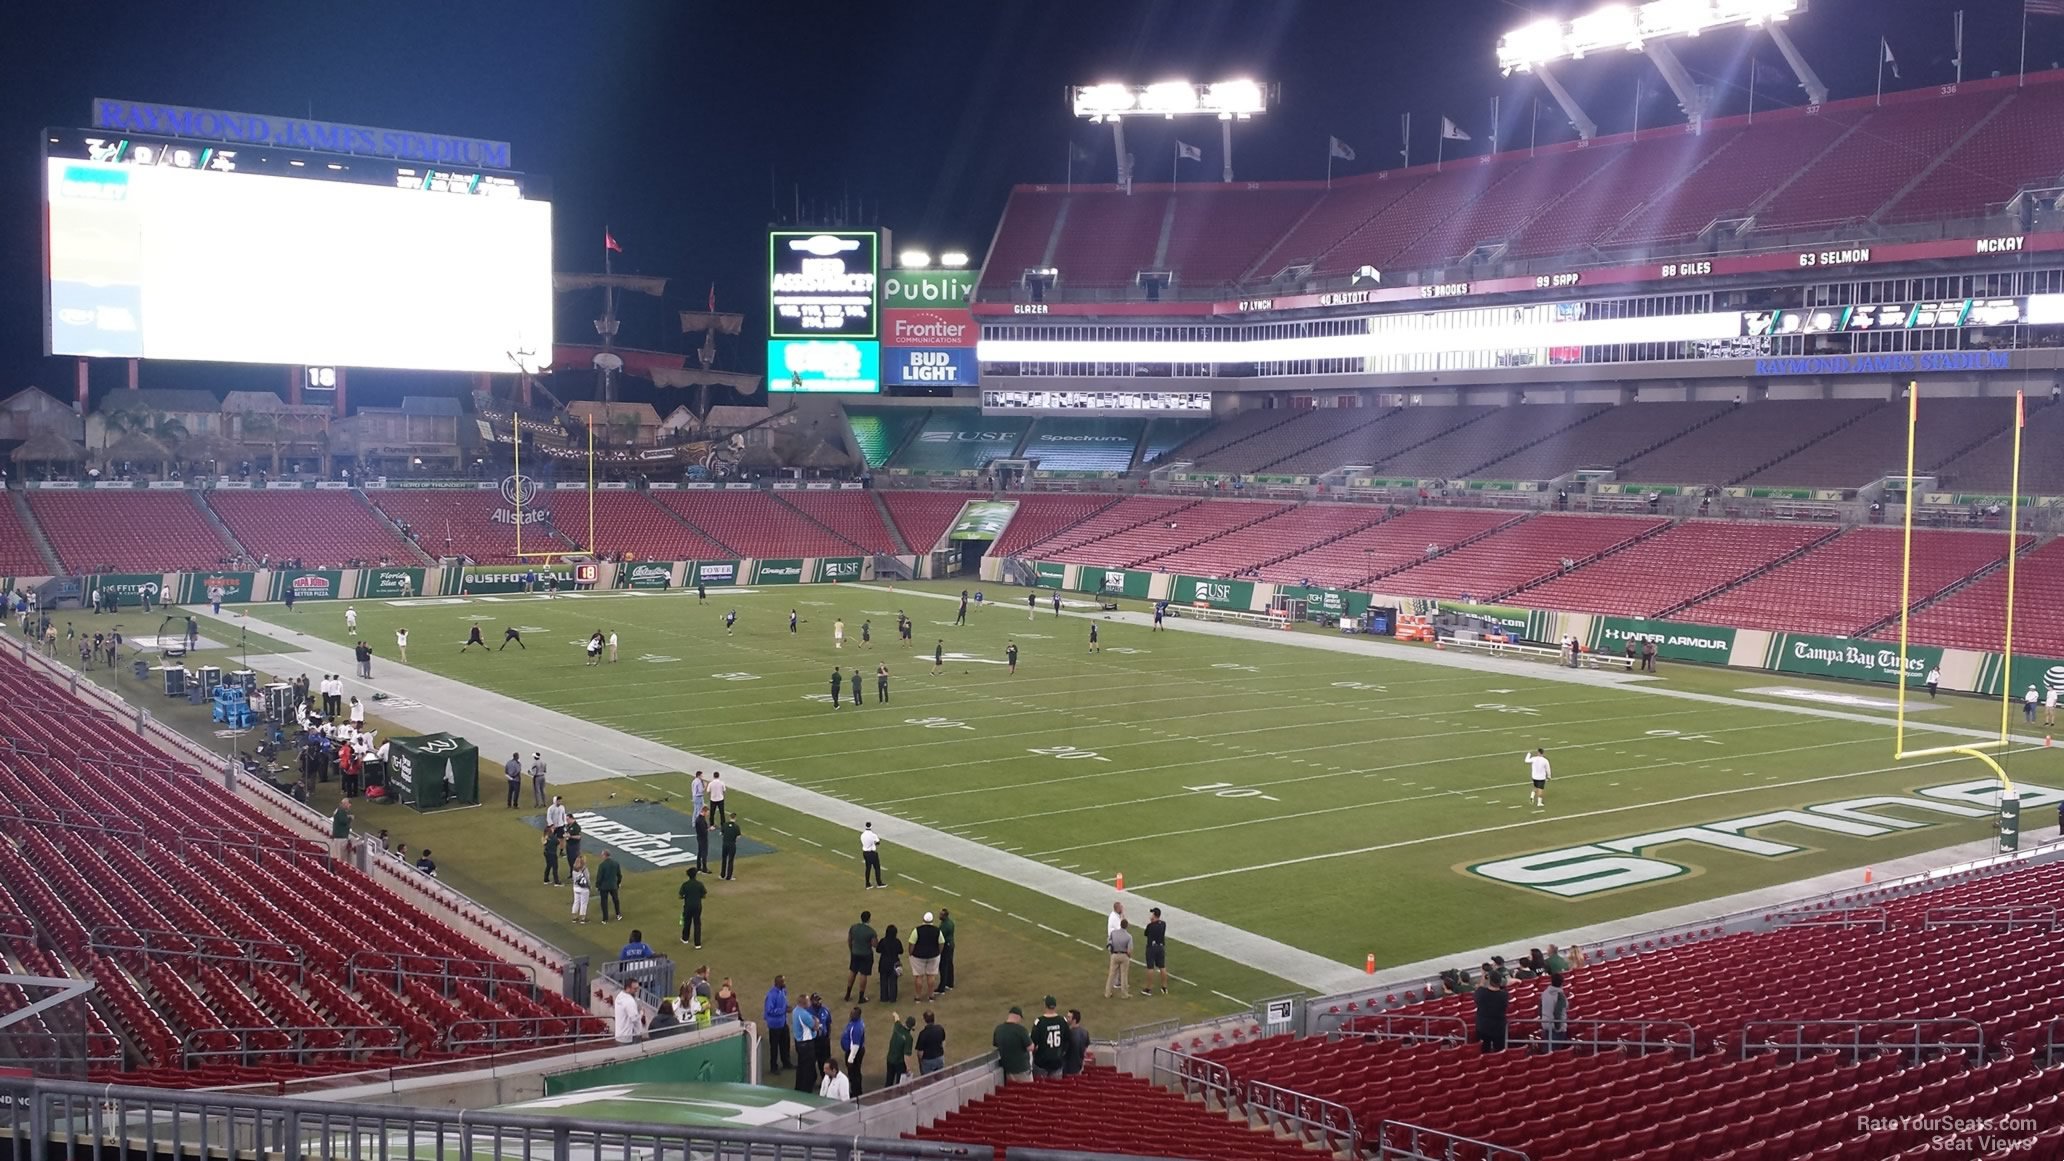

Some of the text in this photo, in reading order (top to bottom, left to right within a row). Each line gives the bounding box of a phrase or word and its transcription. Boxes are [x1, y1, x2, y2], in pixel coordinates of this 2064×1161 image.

[102, 102, 509, 167] RAYMOND JAMES STADIUM
[1799, 249, 1870, 266] 63 SELMON
[1661, 262, 1712, 277] 88 GILES
[1536, 273, 1579, 288] 99 SAPP
[884, 279, 972, 300] Publix
[1421, 284, 1468, 297] 55 BROOKS
[1333, 292, 1369, 303] ALSTOTT
[1014, 305, 1048, 314] GLAZER
[1239, 300, 1272, 311] 47 LYNCH
[896, 320, 965, 337] Frontier
[911, 352, 949, 366] BUD
[1755, 352, 2010, 376] RAYMOND JAMES STADIUM
[308, 367, 334, 386] 18
[903, 367, 957, 380] LIGHT
[957, 432, 1016, 441] USF
[1040, 434, 1128, 442] Spectrum
[491, 508, 545, 525] Allstate
[582, 566, 595, 579] 18
[838, 562, 858, 573] USF
[1208, 584, 1231, 598] USF
[1621, 631, 1665, 643] UNDER
[1795, 641, 1844, 666] Tampa
[1846, 647, 1875, 668] Bay
[905, 717, 966, 728] 30
[1027, 746, 1097, 759] 20
[1183, 783, 1262, 797] 10
[1466, 778, 2064, 897] BULLS
[1046, 1031, 1061, 1048] 46
